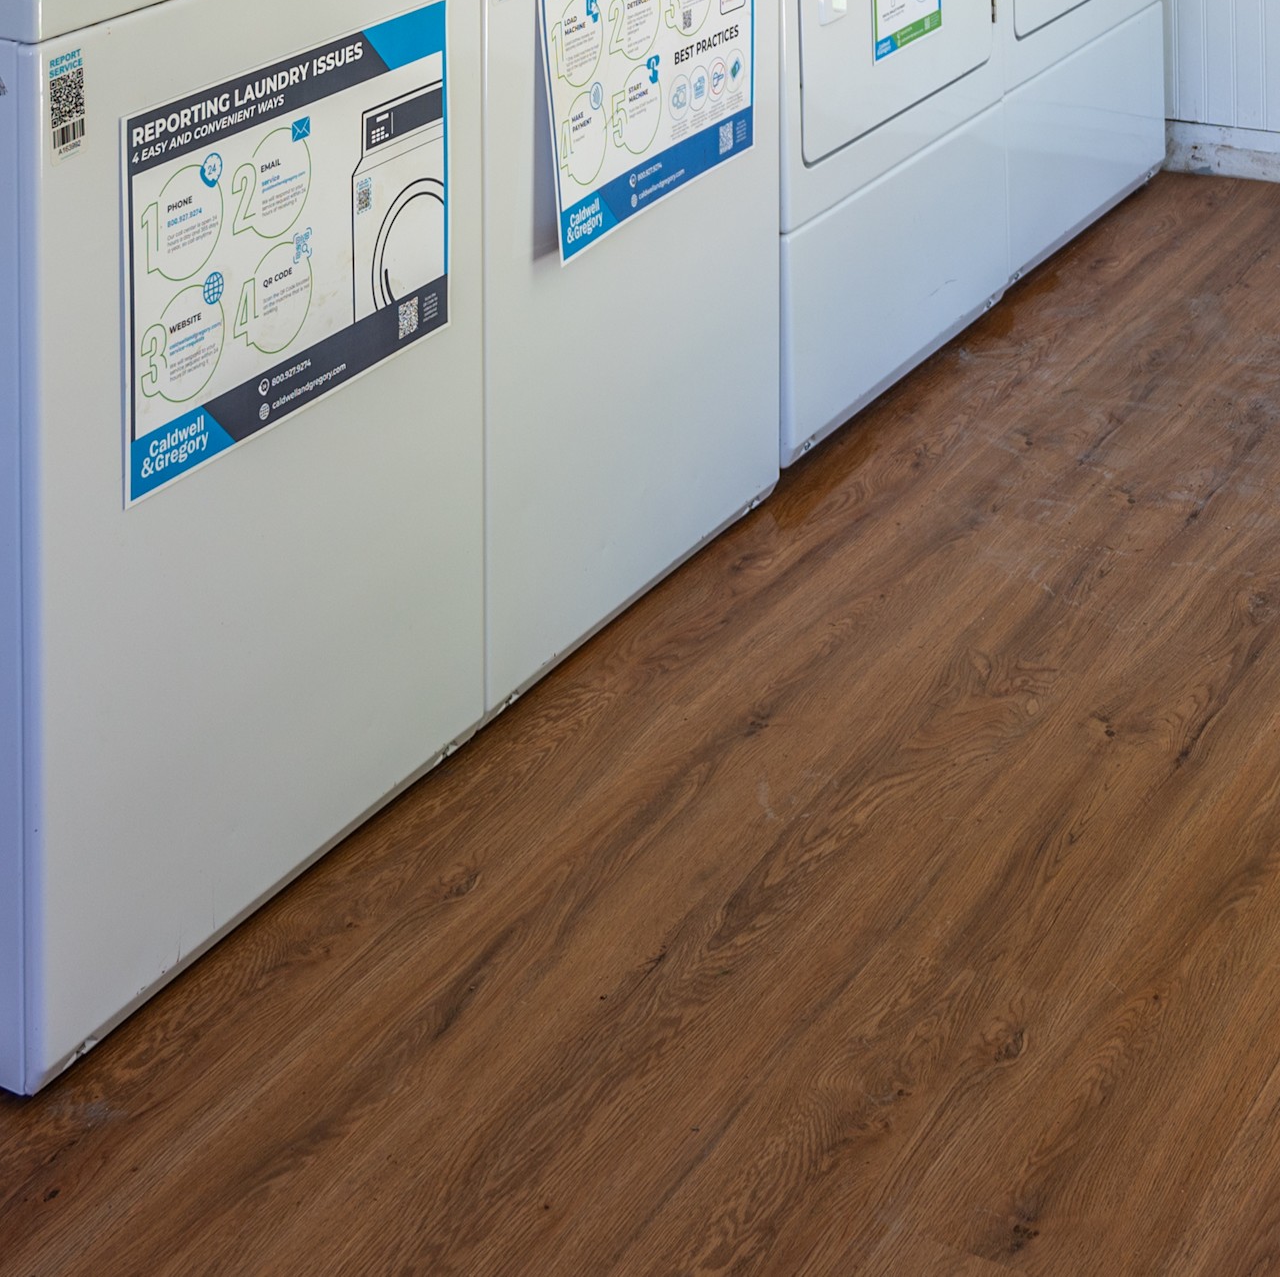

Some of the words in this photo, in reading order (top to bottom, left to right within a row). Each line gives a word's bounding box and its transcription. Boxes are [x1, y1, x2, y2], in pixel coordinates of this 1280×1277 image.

[563, 15, 577, 27] LOAD
[564, 21, 585, 36] MACHINE
[674, 43, 694, 65] BEST
[696, 22, 738, 56] PRACTICES
[49, 58, 83, 78] SERVICE
[50, 49, 81, 68] REPORT
[132, 91, 230, 147] REPORTING
[234, 60, 309, 106] LAUNDRY
[313, 40, 362, 76] ISSUES
[628, 81, 641, 94] START
[571, 111, 583, 123] MAKE
[572, 116, 591, 133] PAYMENT
[132, 150, 139, 165] 4
[141, 139, 168, 161] EASY
[169, 130, 191, 150] AND
[193, 104, 255, 140] CONVENIENT
[257, 93, 284, 115] WAYS
[208, 164, 217, 176] 24
[260, 157, 280, 173] EMAIL
[167, 195, 192, 213] PHONE
[569, 197, 601, 228] Caldwell
[567, 210, 603, 244] &Gregory
[263, 276, 272, 289] QR
[274, 266, 292, 282] CODE
[169, 311, 201, 334] WEBSITE
[271, 359, 311, 387] 800.927.9274
[272, 362, 346, 410] caldwellandgregory.com
[149, 415, 204, 457] Caldwell
[141, 432, 208, 478] &Gregory
